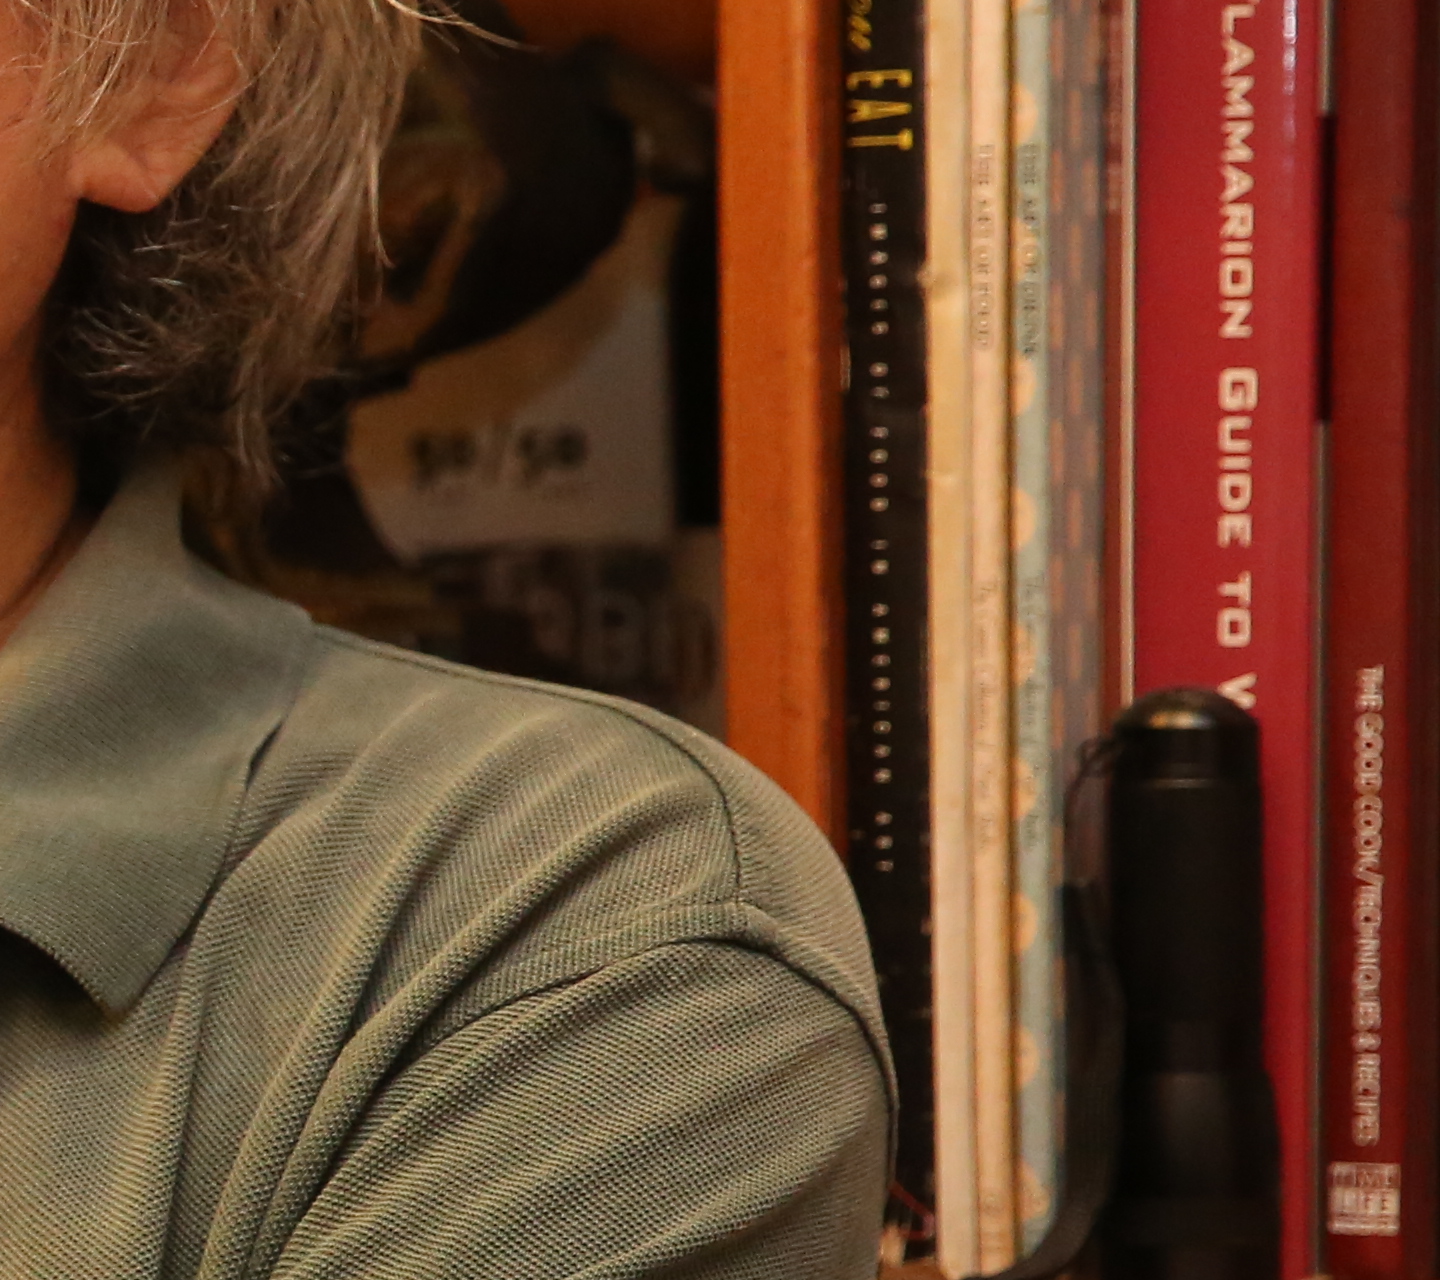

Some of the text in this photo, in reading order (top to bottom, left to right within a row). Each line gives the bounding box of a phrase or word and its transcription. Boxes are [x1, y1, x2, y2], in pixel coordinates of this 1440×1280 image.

[849, 67, 914, 152] EAT
[1217, 366, 1260, 546] GUIDE
[1217, 575, 1253, 648] TO
